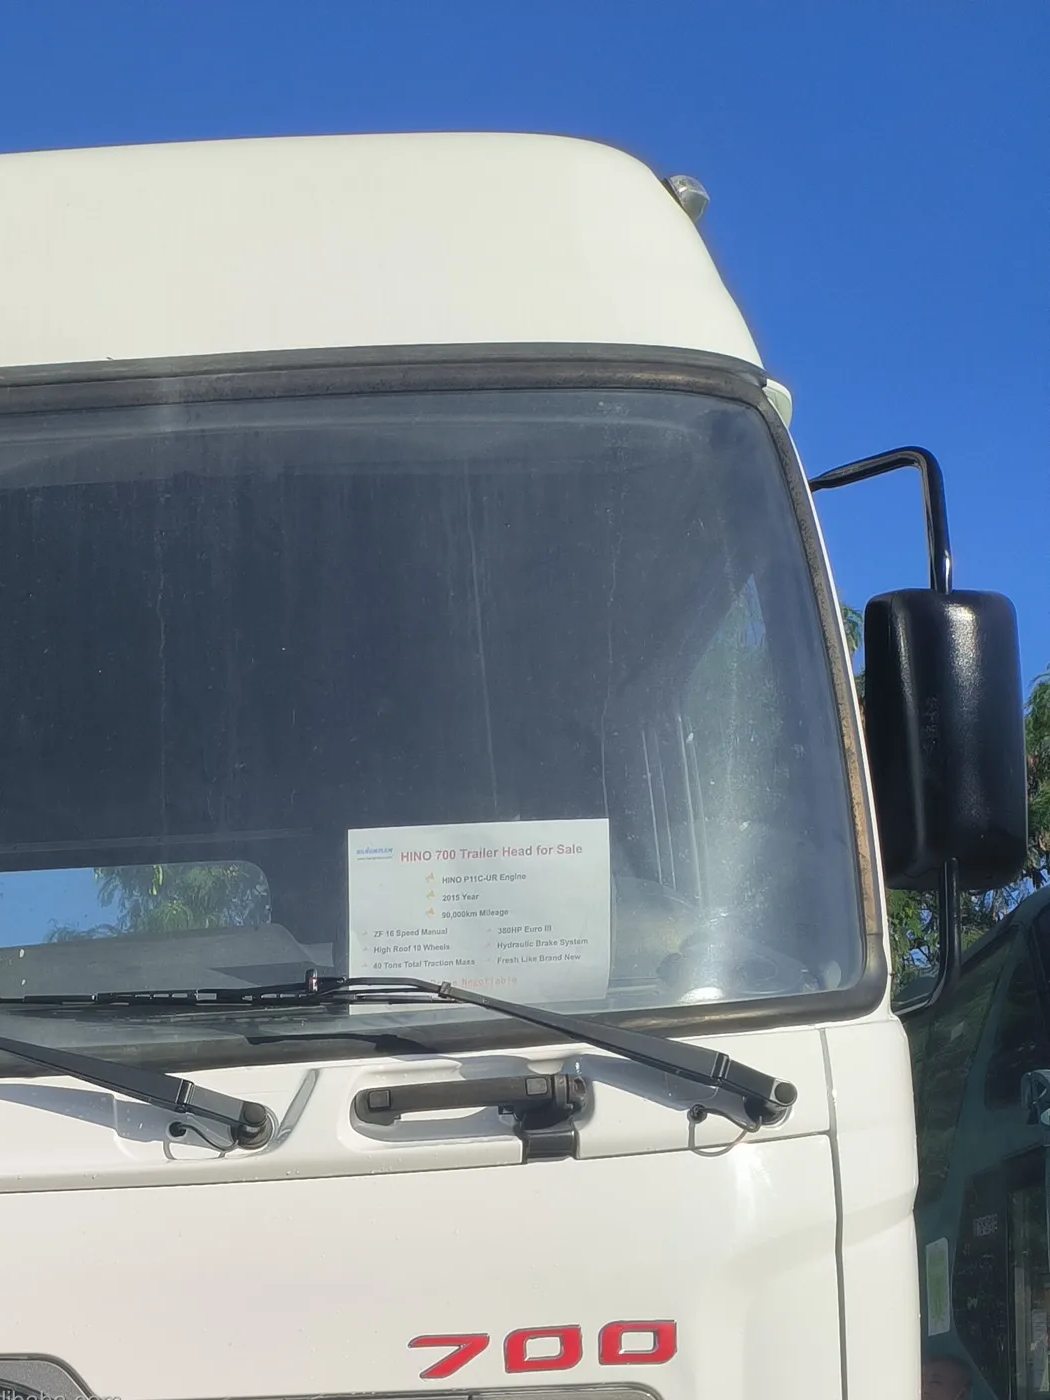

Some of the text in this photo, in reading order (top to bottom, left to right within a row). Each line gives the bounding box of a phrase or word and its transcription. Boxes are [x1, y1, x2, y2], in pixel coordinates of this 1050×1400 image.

[400, 850, 432, 862] HINO
[435, 849, 456, 860] 700
[459, 847, 499, 859] Trailer
[502, 846, 533, 857] Head
[536, 845, 553, 856] for
[556, 844, 583, 855] Sale
[442, 876, 462, 884] HINO
[499, 873, 527, 882] Engine
[461, 893, 480, 901] Year
[479, 909, 509, 918] Mileage
[373, 930, 384, 938] ZF
[396, 929, 420, 938] Speed
[421, 928, 448, 936] Manual
[373, 943, 450, 955] High Roof 10 Wheels
[497, 937, 589, 950] Hydraulic Brake System
[373, 958, 476, 970] 40 Tons Total Traction Mass
[497, 956, 519, 964] Fresh
[521, 955, 538, 963] Like
[539, 954, 562, 962] Brand
[408, 1320, 678, 1380] 700
